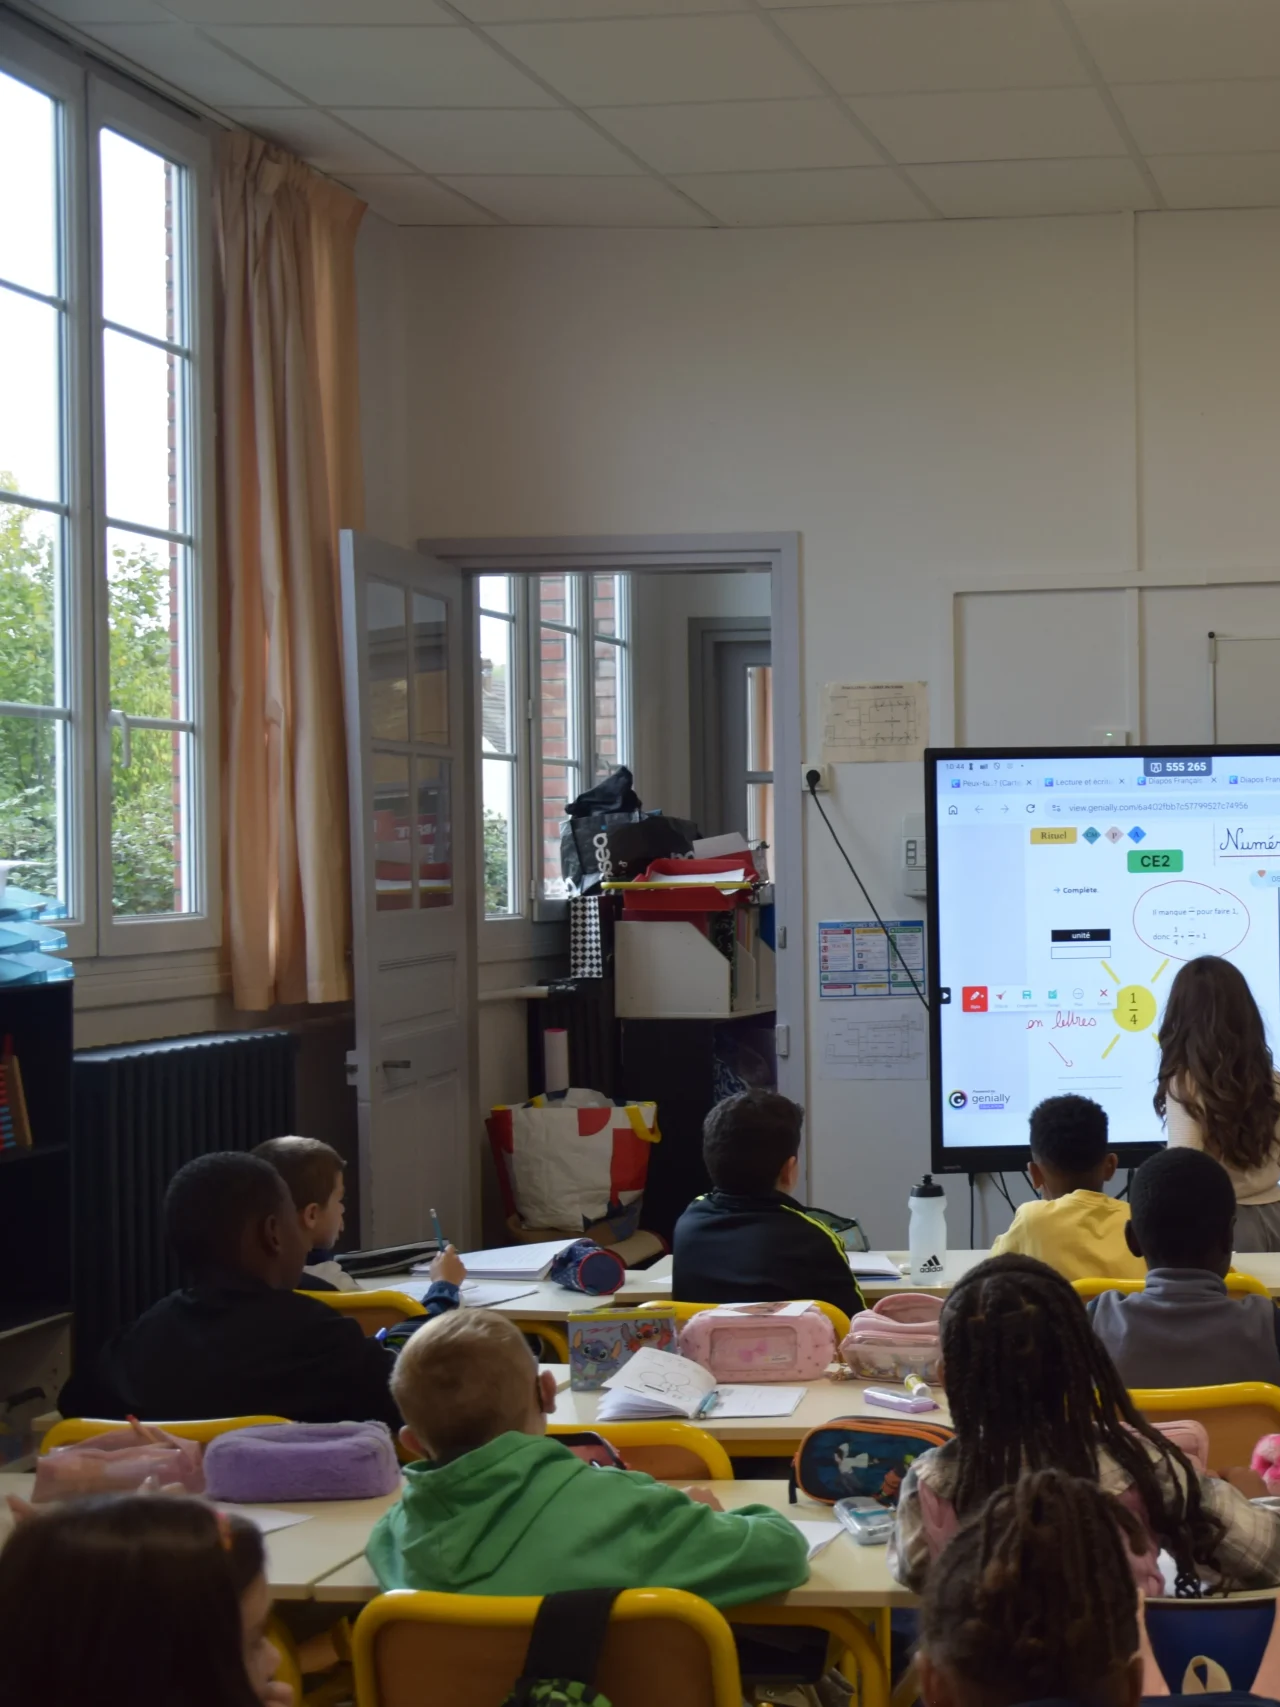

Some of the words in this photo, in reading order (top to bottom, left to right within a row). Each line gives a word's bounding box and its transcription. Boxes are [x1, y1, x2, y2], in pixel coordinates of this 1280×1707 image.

[1165, 762, 1185, 772] 555
[1187, 762, 1207, 772] 265
[1055, 778, 1083, 786] Lecture
[1084, 778, 1092, 786] et
[1148, 777, 1172, 786] Diapos
[1240, 776, 1265, 785] Diapos
[1040, 831, 1067, 840] Rituel
[1140, 855, 1171, 868] CE2
[1158, 909, 1187, 917] manque
[1196, 908, 1213, 916] pour
[1071, 931, 1091, 940] unité
[1130, 992, 1137, 1004] 1
[1025, 1018, 1044, 1030] en
[1051, 1010, 1098, 1030] lettres
[1129, 1013, 1138, 1025] 4
[971, 1093, 1011, 1105] genially
[919, 1265, 944, 1273] adidas
